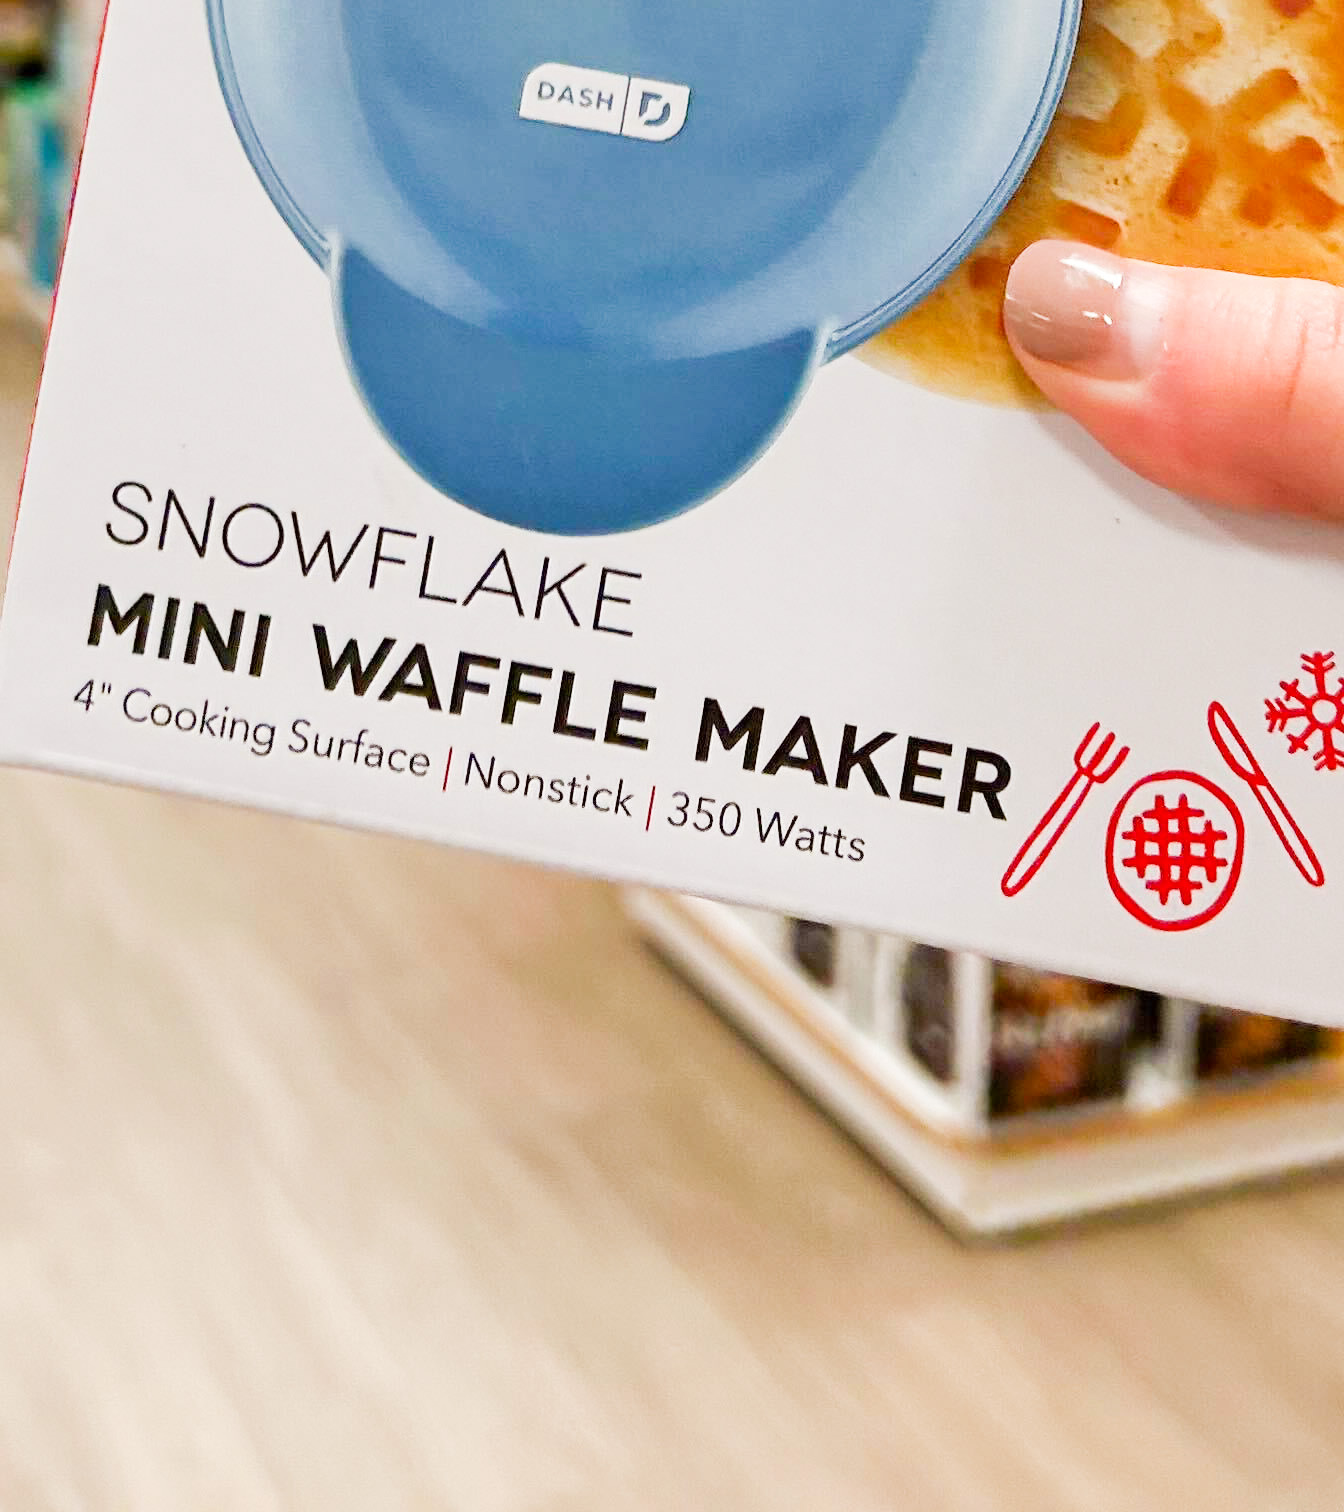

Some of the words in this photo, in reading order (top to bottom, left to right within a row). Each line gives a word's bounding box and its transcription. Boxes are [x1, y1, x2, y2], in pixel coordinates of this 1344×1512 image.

[537, 81, 615, 112] DASH
[105, 481, 643, 638] SNOWFLAKE
[73, 678, 114, 713] 4"
[122, 687, 276, 757] Cooking
[289, 718, 431, 776] Surface
[464, 751, 635, 818] Nonstick
[666, 791, 743, 837] 350
[756, 807, 867, 864] Watts
[87, 582, 273, 678] MINI
[311, 622, 658, 752] WAFFLE
[694, 696, 1013, 821] MAKER
